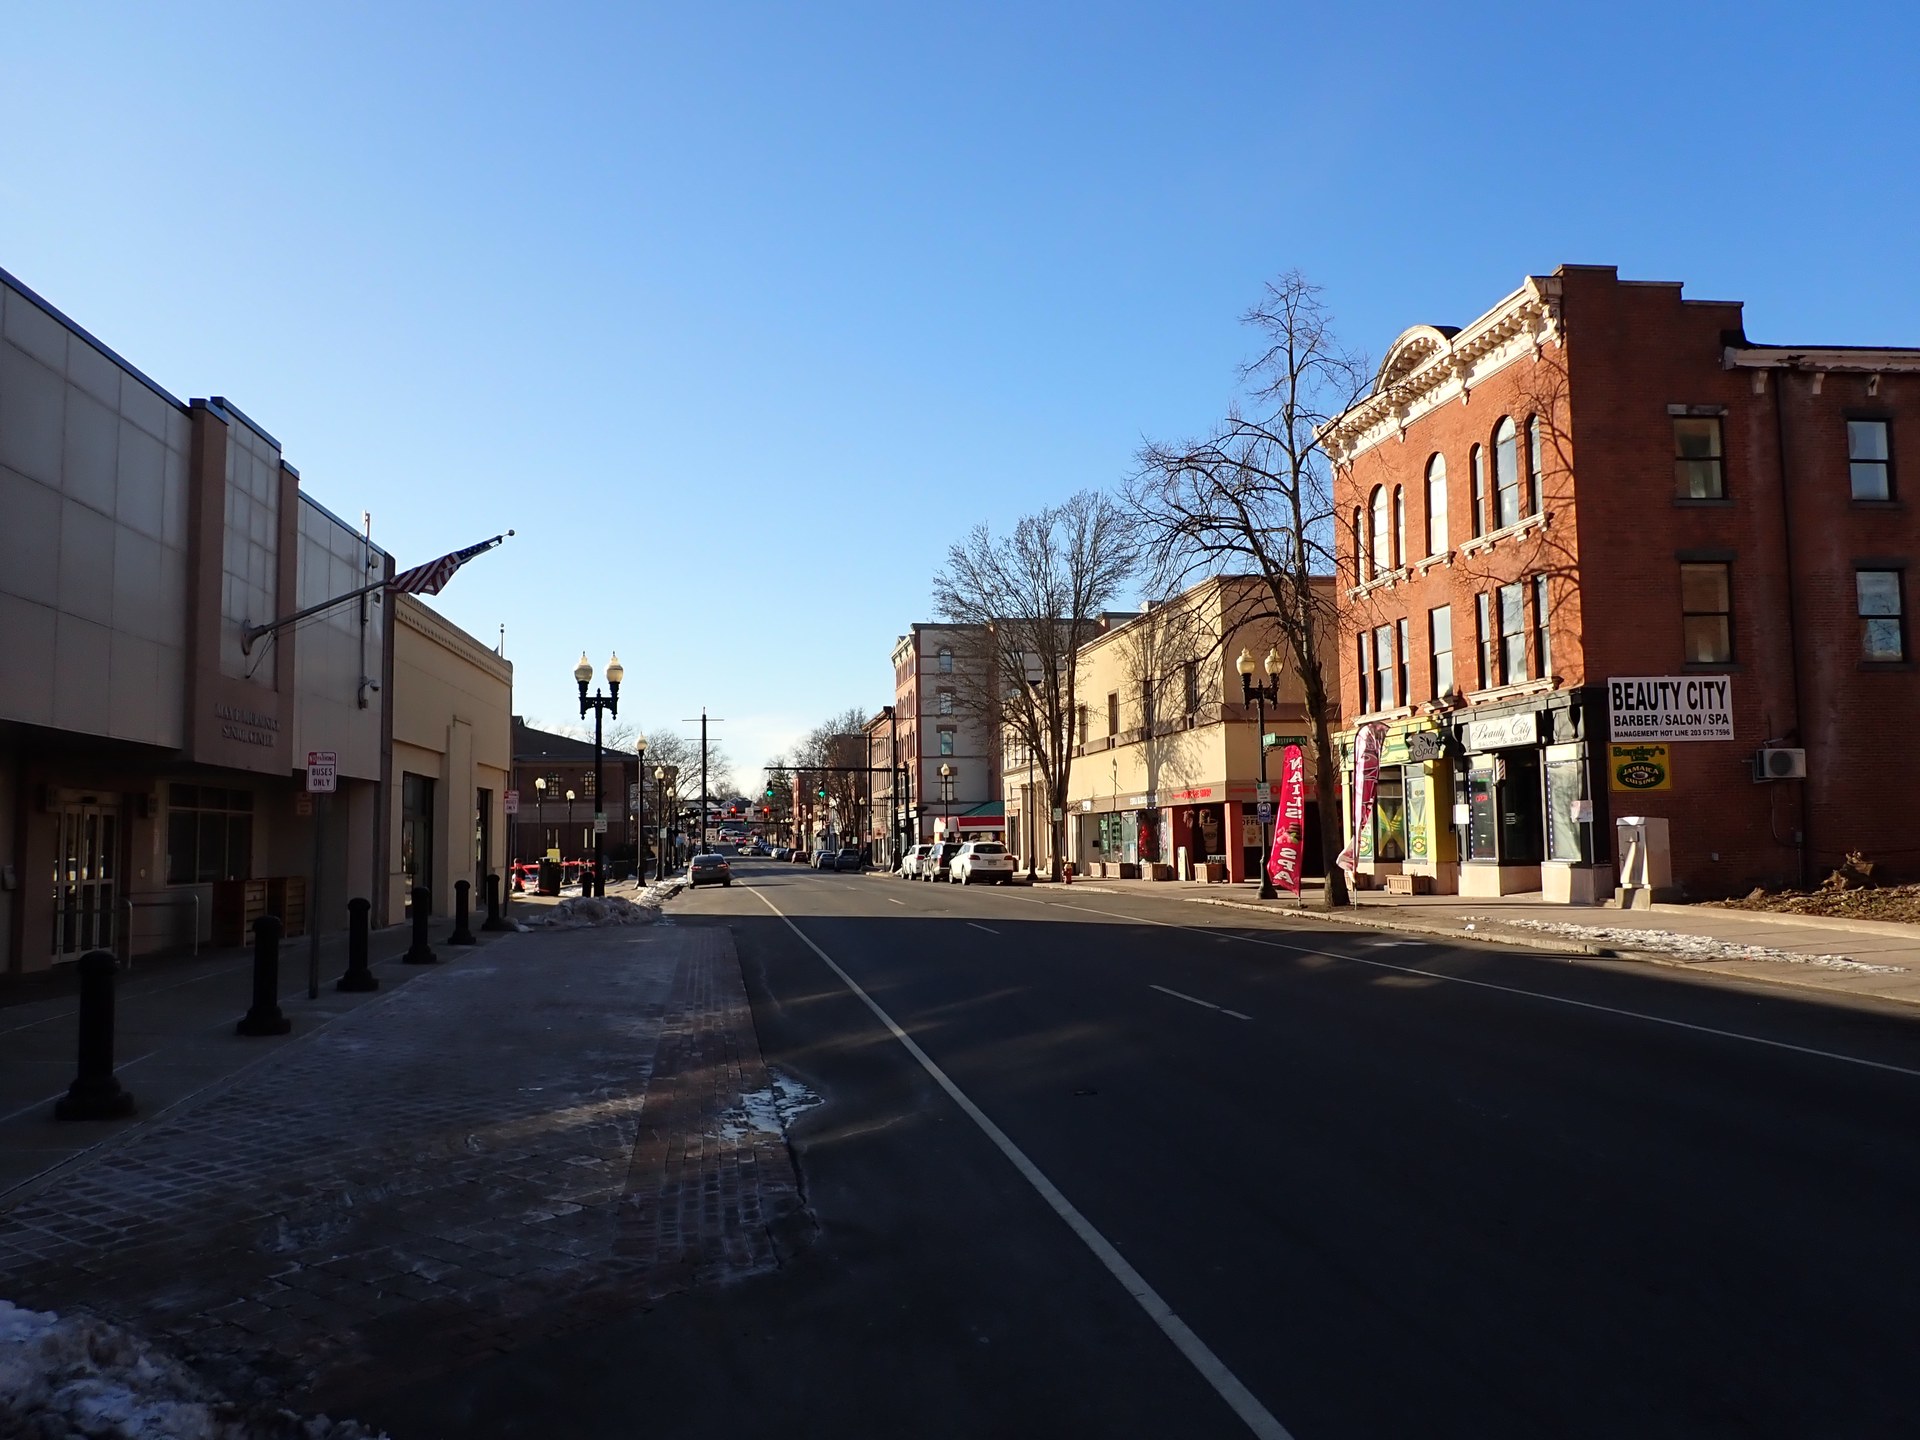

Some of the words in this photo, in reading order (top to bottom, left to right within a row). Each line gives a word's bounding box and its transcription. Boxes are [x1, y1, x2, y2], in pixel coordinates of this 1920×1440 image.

[1612, 682, 1681, 711] BEAUTY
[1687, 681, 1726, 710] CITY
[1471, 723, 1506, 741] Beauty
[1511, 718, 1532, 740] City
[1614, 730, 1658, 738] MANAGEMENT
[1415, 744, 1438, 759] Spa
[312, 768, 332, 776] BUSES
[1622, 765, 1659, 776] JAMAICA
[314, 779, 330, 787] ONLY
[1624, 777, 1656, 786] CUISINE
